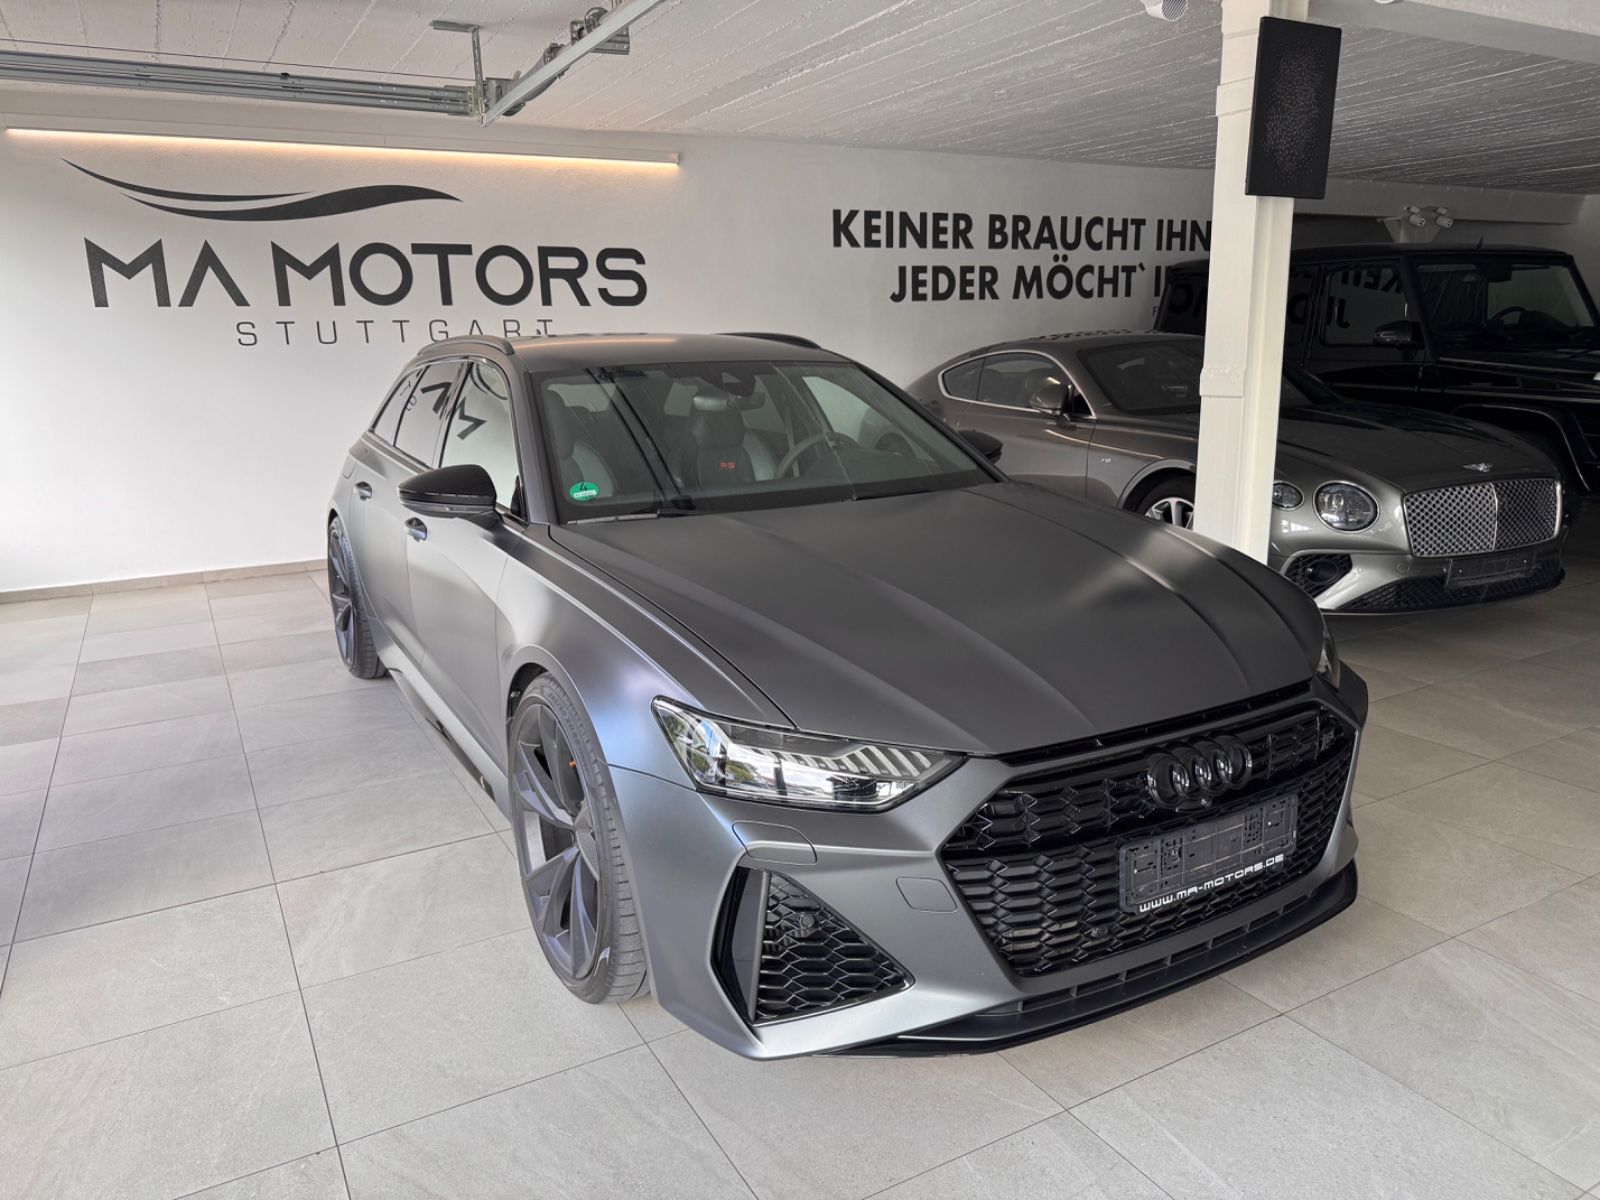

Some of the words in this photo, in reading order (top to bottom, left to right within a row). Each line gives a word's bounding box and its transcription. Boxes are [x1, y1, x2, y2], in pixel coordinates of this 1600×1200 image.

[832, 209, 974, 250] KEINER
[988, 213, 1147, 252] BRAUCHT
[1156, 218, 1212, 252] IHN
[84, 237, 251, 308] MA
[270, 240, 648, 308] MOTORS
[890, 265, 1000, 303] JEDER
[236, 319, 553, 347] STUTTGART
